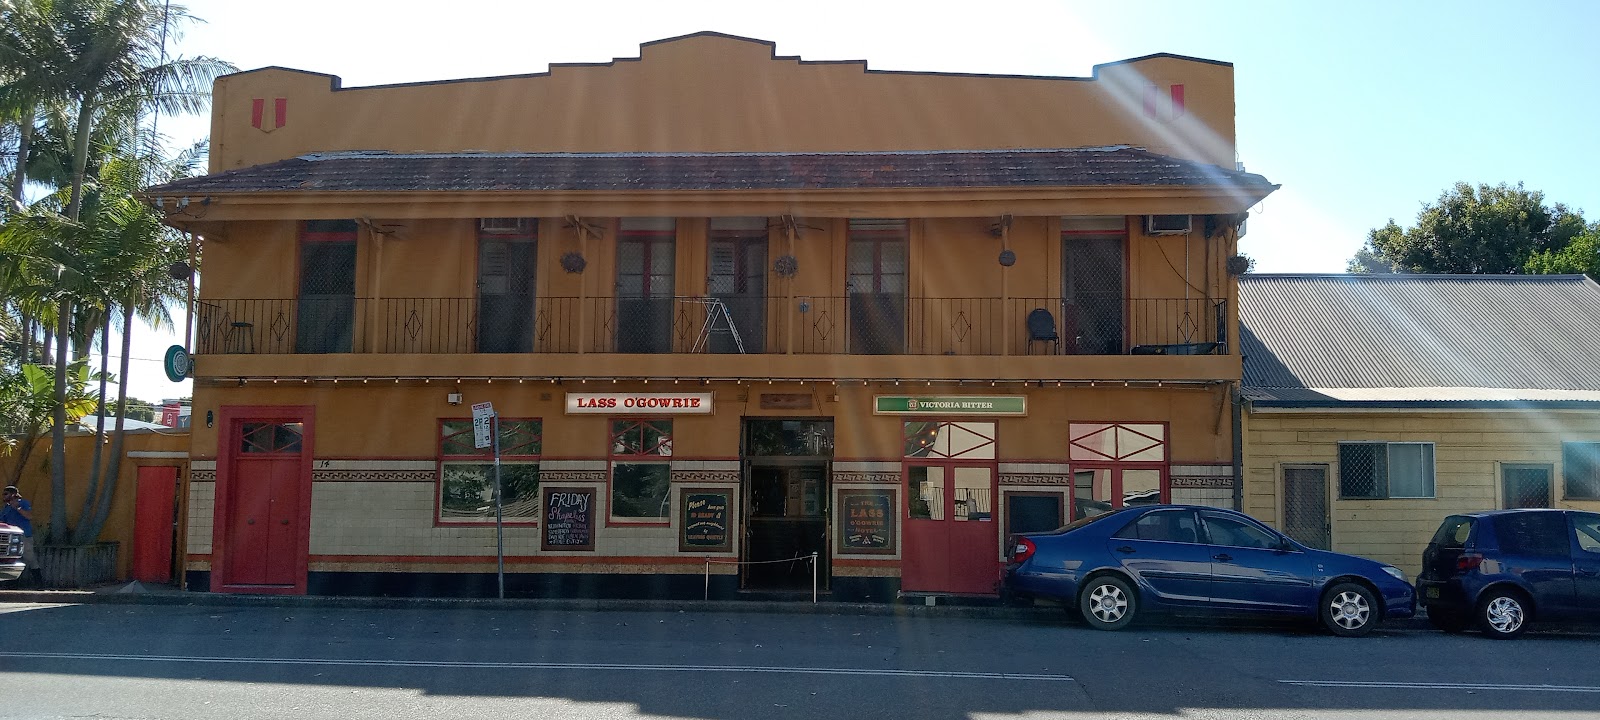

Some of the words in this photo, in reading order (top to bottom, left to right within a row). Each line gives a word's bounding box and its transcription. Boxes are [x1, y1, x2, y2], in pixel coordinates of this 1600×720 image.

[577, 397, 616, 408] LASS
[624, 397, 700, 408] O'GOWRIE
[962, 401, 993, 409] BITTER
[319, 460, 330, 468] 14
[550, 492, 590, 512] FRIDAY
[850, 508, 884, 518] LASS
